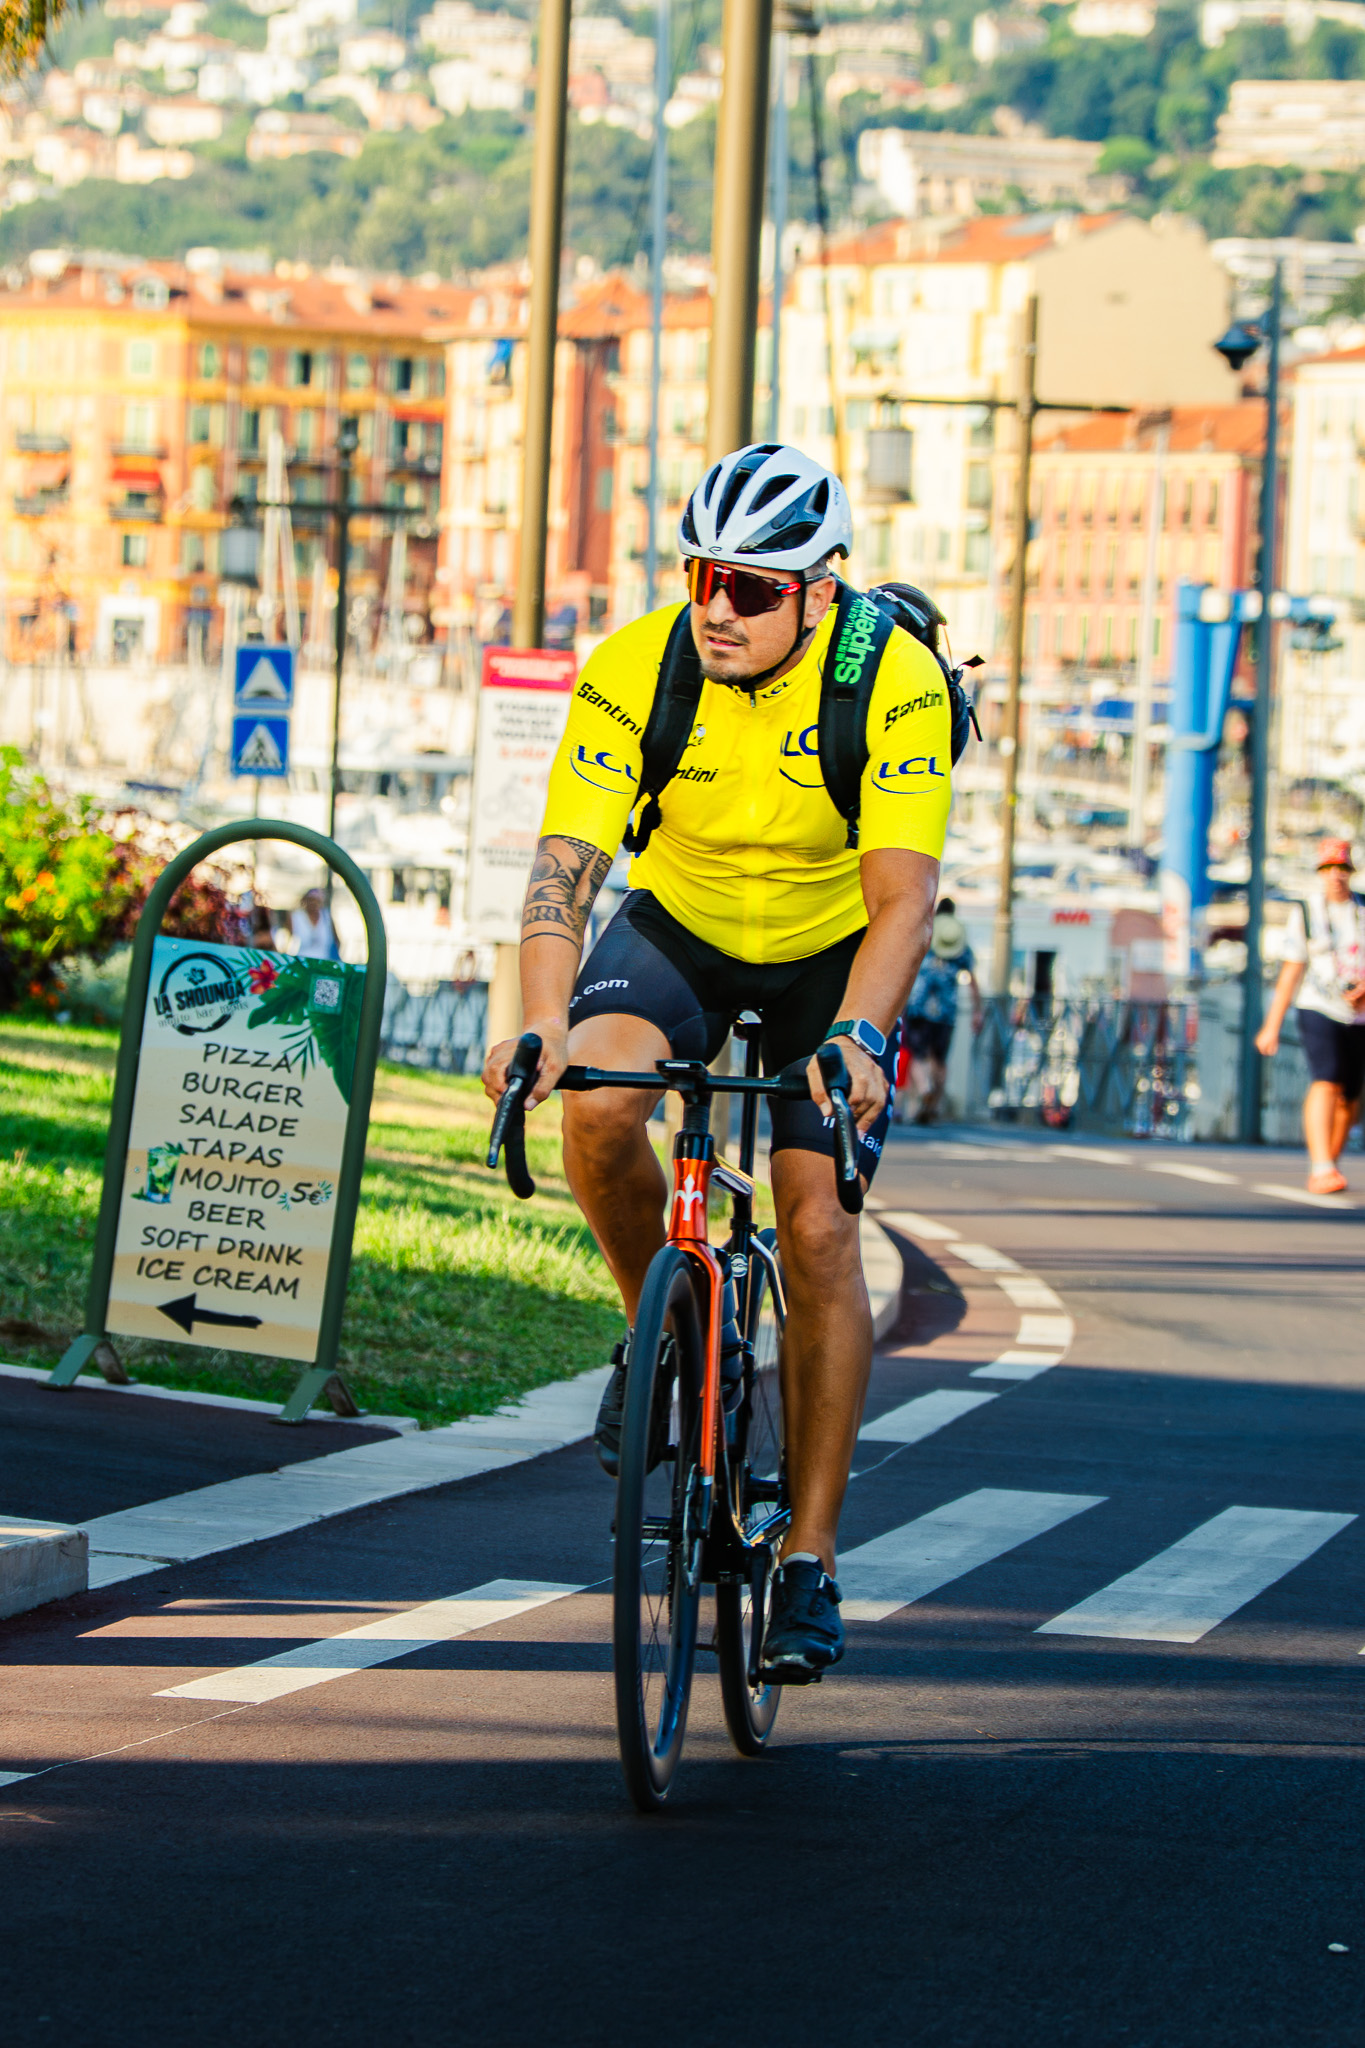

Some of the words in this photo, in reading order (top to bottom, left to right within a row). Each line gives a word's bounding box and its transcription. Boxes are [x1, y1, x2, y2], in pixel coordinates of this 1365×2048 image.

[834, 596, 880, 684] Superd
[577, 682, 642, 735] Santini
[884, 689, 944, 733] Santini
[784, 724, 819, 756] LC
[578, 745, 638, 783] LCL
[676, 766, 719, 782] ntini
[879, 757, 945, 779] LCL
[154, 992, 172, 1015] LA
[174, 979, 246, 1011] SHOUNGA
[203, 1043, 291, 1073] PIZZA
[183, 1072, 303, 1107] BURGER
[179, 1103, 298, 1137] SALADE
[187, 1138, 283, 1168] TAPAS
[180, 1167, 280, 1199] MOJITO
[290, 1182, 322, 1205] 5€
[188, 1201, 266, 1231] BEER
[139, 1226, 208, 1252] SOFT
[217, 1237, 303, 1266] DRINK
[137, 1256, 184, 1280] ICE
[193, 1265, 299, 1299] CREAM
